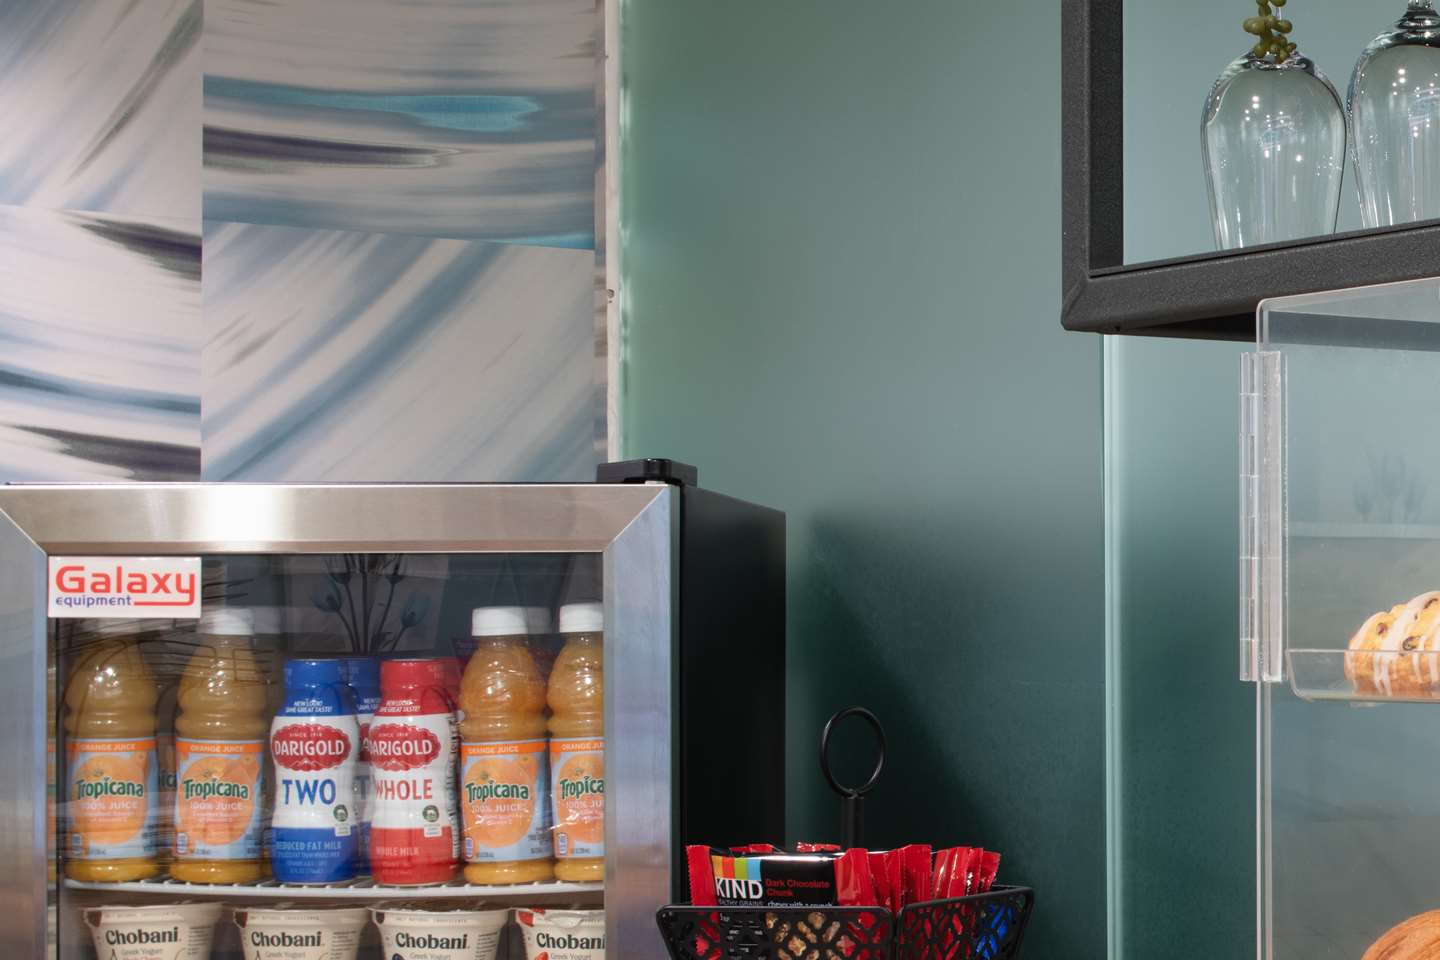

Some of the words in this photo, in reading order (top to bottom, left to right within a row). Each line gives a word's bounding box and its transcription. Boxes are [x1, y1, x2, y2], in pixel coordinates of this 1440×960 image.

[55, 566, 195, 606] Galaxy
[56, 596, 131, 607] equipment
[275, 740, 344, 756] DARIGOLD
[76, 777, 144, 800] Tropicana
[184, 779, 249, 800] Tropicana
[282, 778, 336, 805] TWO
[376, 779, 433, 800] WHOLE
[465, 780, 529, 803] Tropicana
[560, 776, 605, 799] Tropica
[215, 802, 243, 810] JUICE
[307, 841, 322, 850] FAT
[323, 841, 341, 850] MILK
[401, 847, 419, 856] MILK
[716, 877, 763, 899] KIND
[765, 879, 785, 887] Dark
[786, 879, 831, 888] Chocolate
[105, 926, 178, 945] Chobani
[251, 931, 322, 947] Chobani
[395, 932, 468, 949] Chobani
